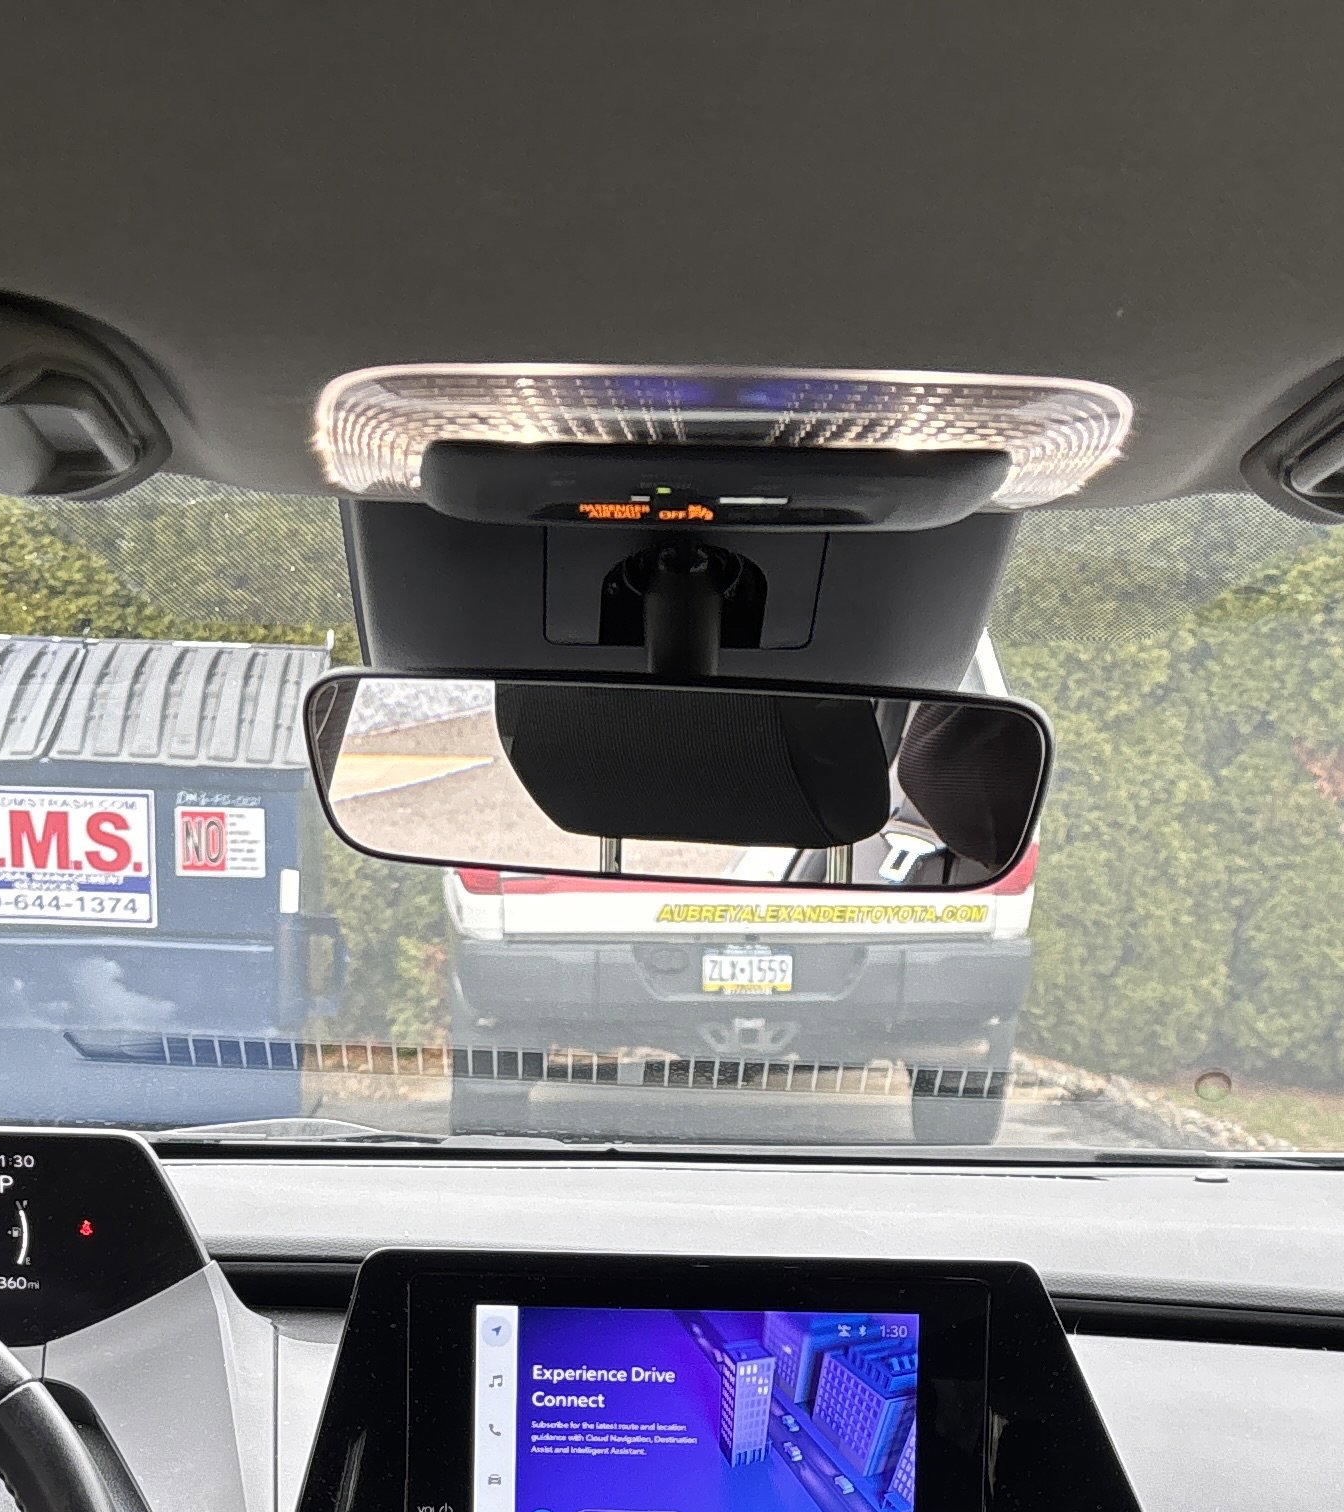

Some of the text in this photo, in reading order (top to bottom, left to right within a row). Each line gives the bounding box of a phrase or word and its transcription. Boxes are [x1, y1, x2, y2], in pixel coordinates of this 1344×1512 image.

[182, 818, 224, 864] NO
[657, 904, 988, 924] AUBREYALEXANDERTOYOTA.COM
[0, 1174, 14, 1194] P
[879, 1324, 908, 1338] 1:30
[532, 1364, 676, 1384] Experience Drive
[531, 1391, 606, 1408] Connect
[531, 1420, 570, 1429] Subscribe
[581, 1421, 595, 1430] the
[617, 1423, 639, 1431] route
[640, 1422, 656, 1431] and
[530, 1432, 567, 1443] guidance
[567, 1433, 585, 1442] with
[585, 1433, 609, 1442] Cloud
[530, 1444, 554, 1454] Assist
[554, 1445, 570, 1454] and
[570, 1445, 609, 1456] Intelligent
